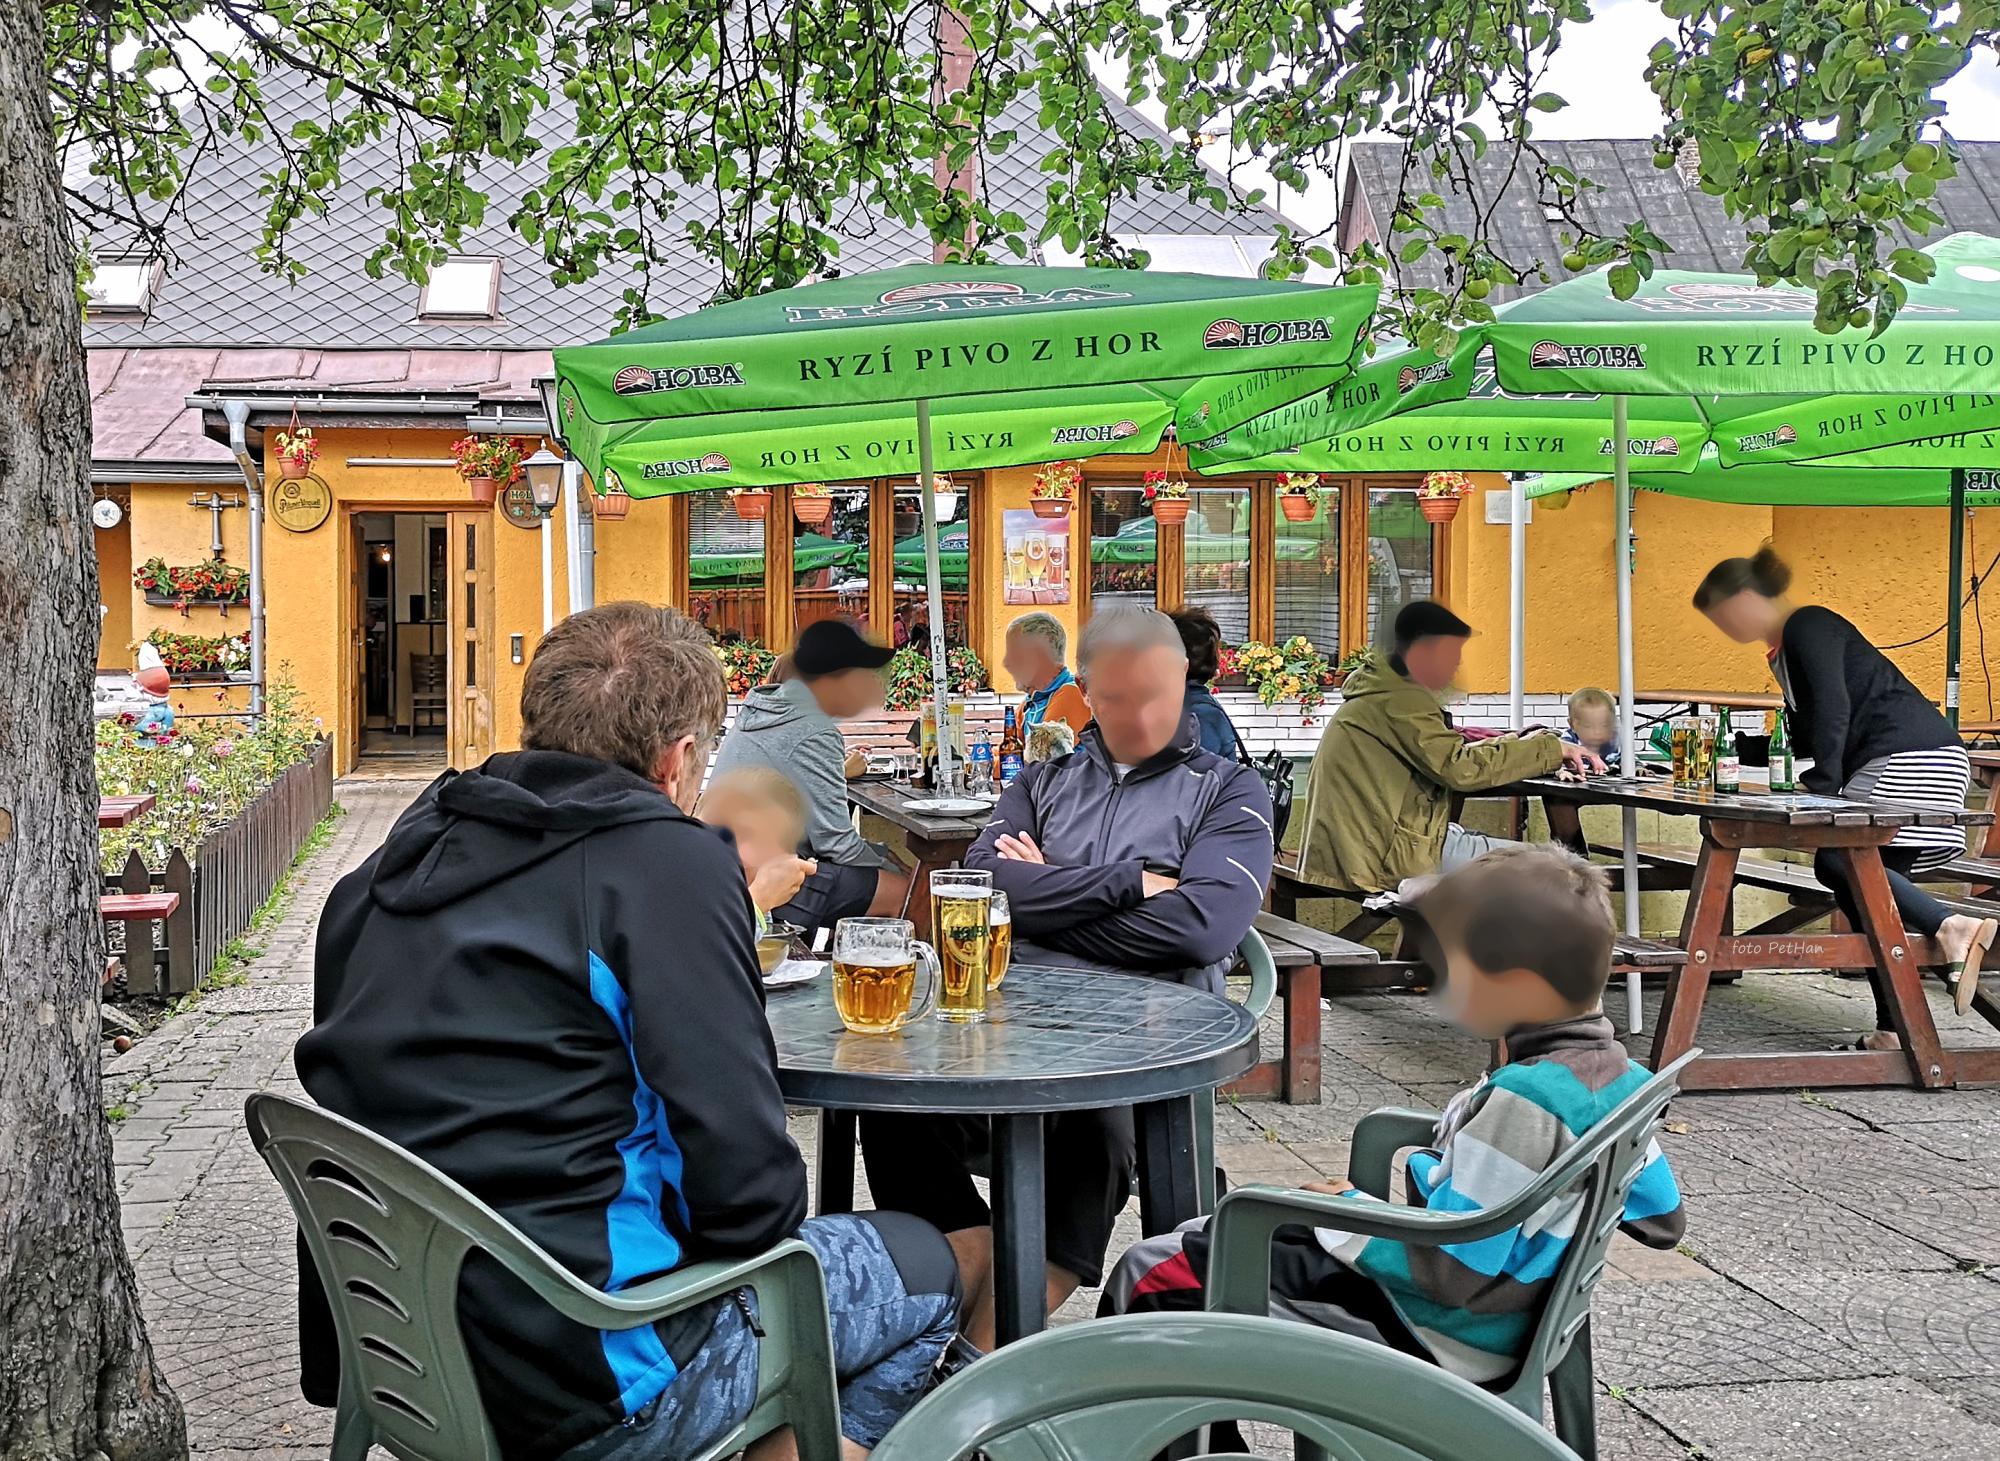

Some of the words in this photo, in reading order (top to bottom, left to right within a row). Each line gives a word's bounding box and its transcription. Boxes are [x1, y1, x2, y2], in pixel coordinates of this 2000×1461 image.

[1239, 319, 1332, 347] HOLBA
[798, 345, 893, 381] RYZÍ
[914, 342, 1010, 371] PIVO
[1031, 339, 1053, 362] Z
[1074, 331, 1163, 358] HOR
[1561, 346, 1646, 369] HOLBA
[1696, 337, 1782, 367] RYZÍ
[1801, 343, 1886, 365] PIVO
[1905, 344, 1925, 365] Z
[1944, 344, 1994, 367] HO
[651, 363, 745, 392] HOLBA
[1284, 399, 1319, 426] PIVO
[1342, 382, 1381, 410] HOR
[510, 490, 533, 499] HOL
